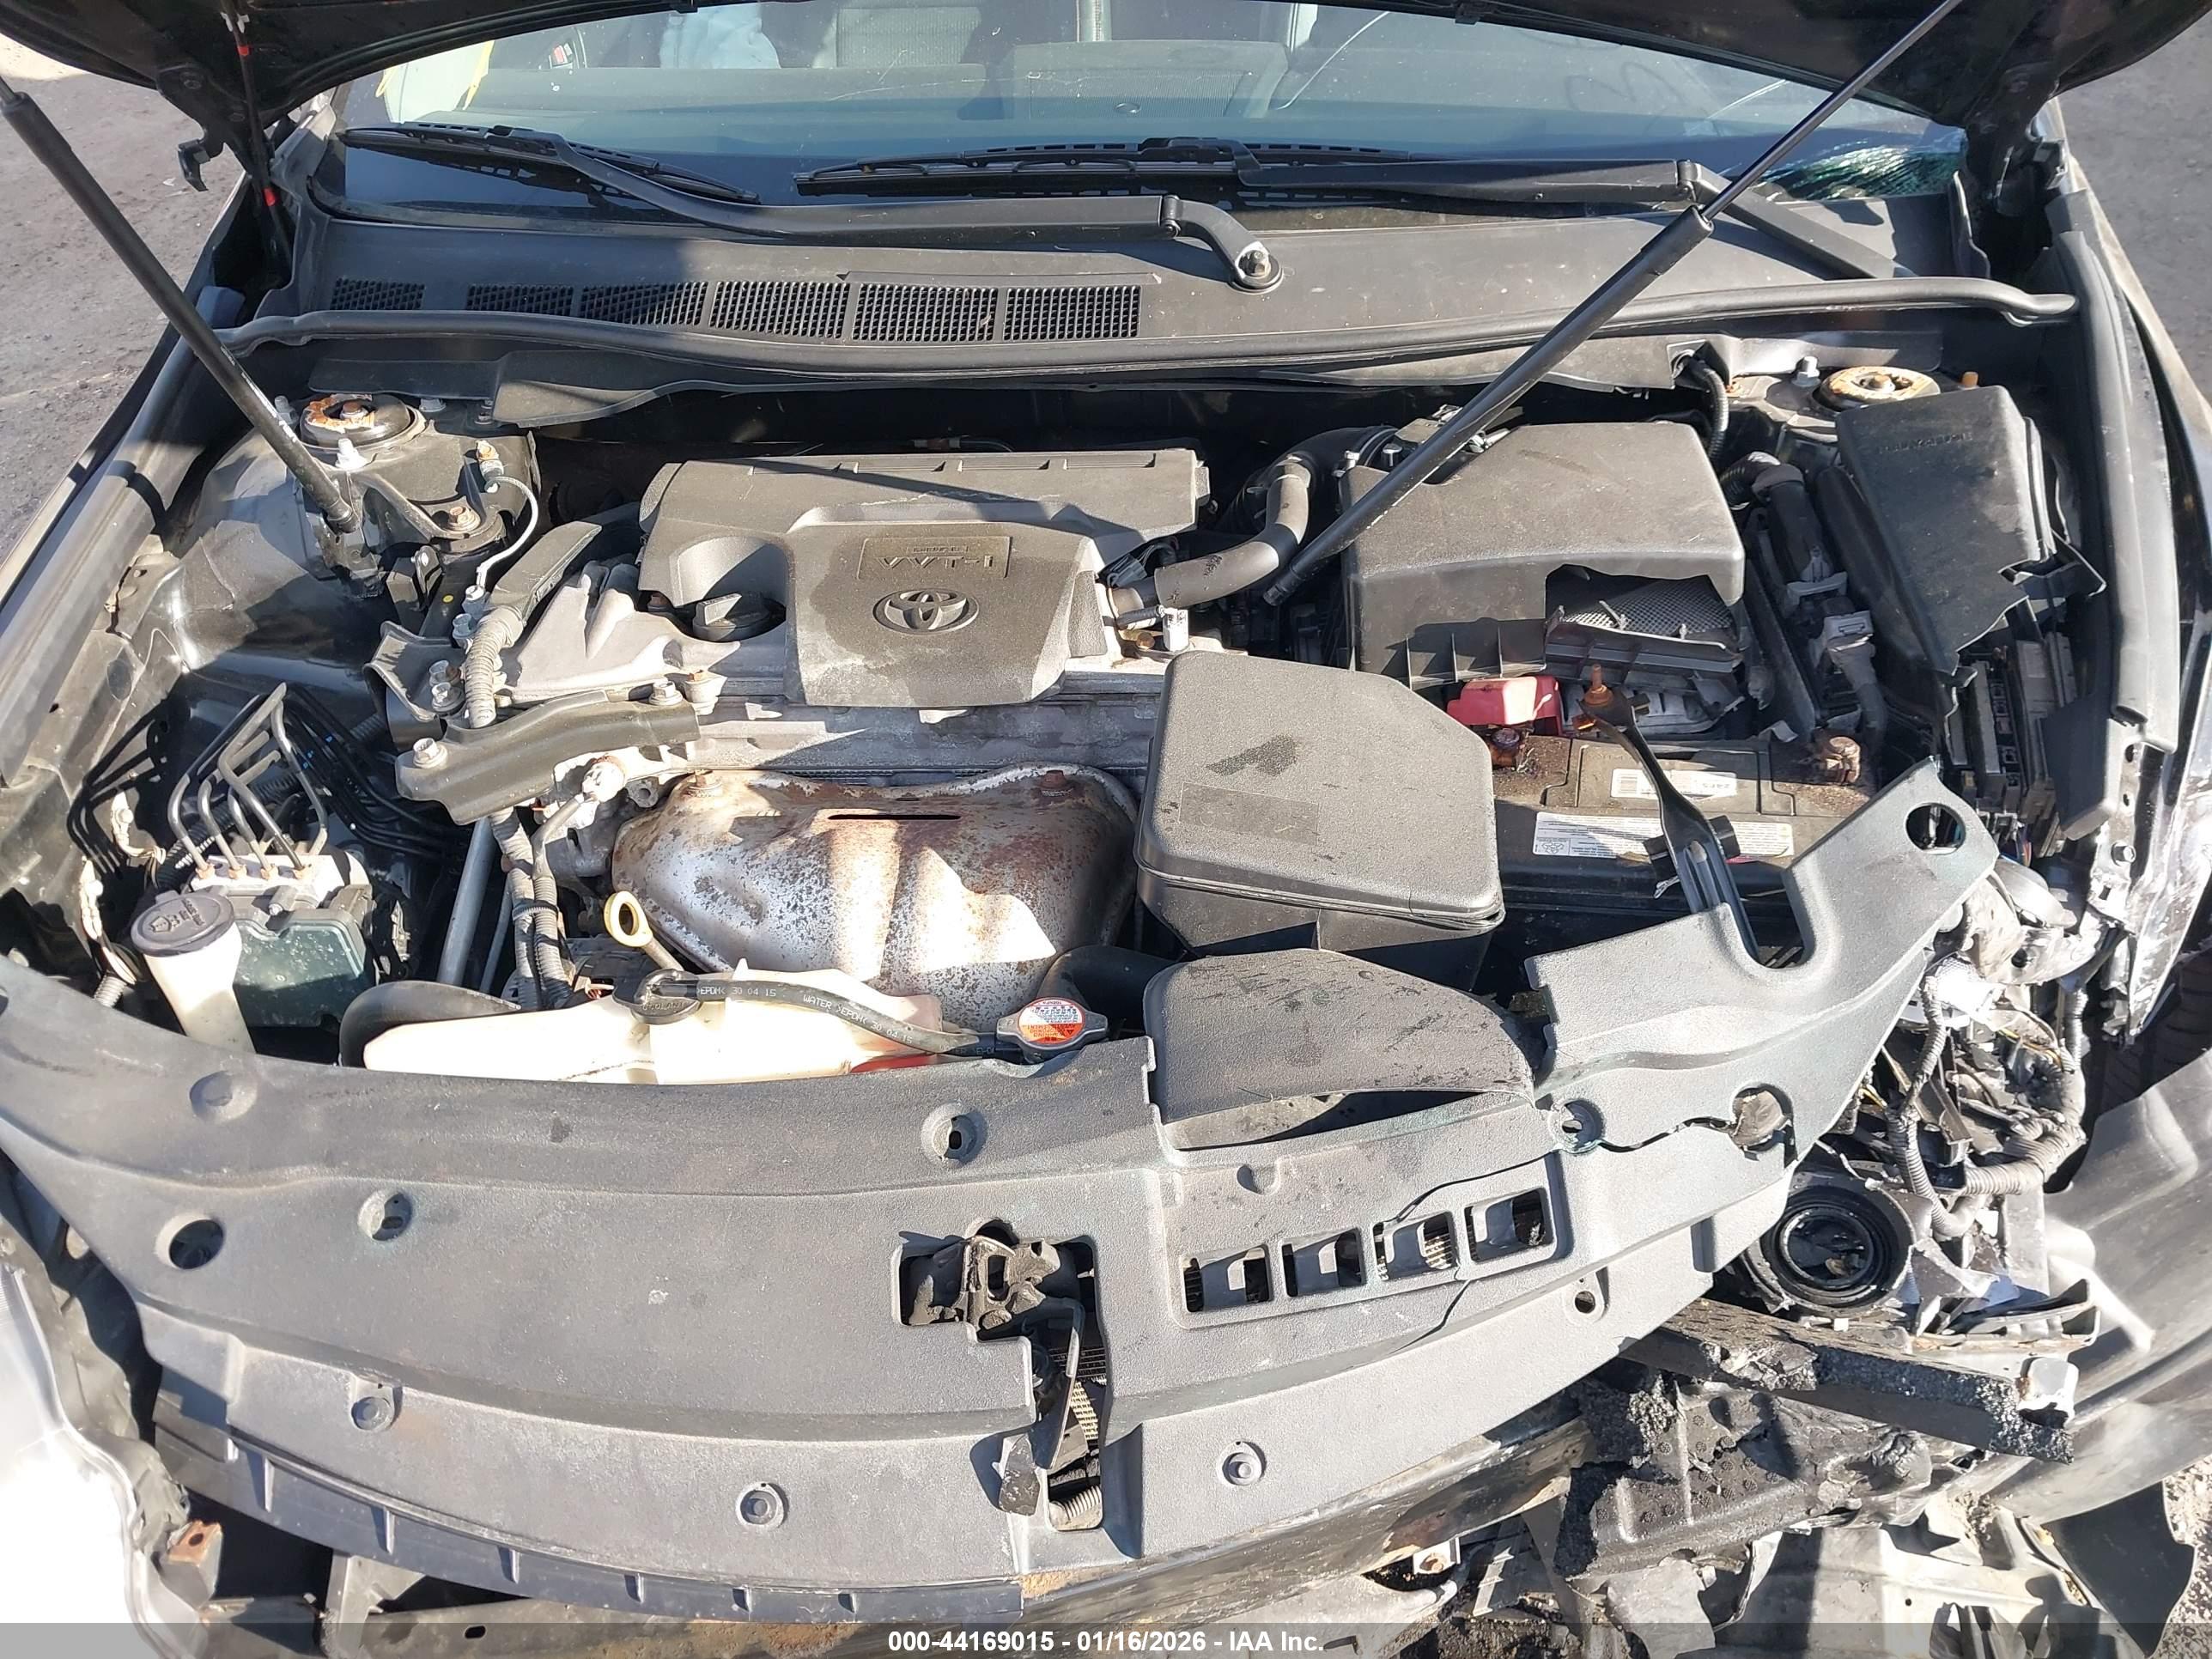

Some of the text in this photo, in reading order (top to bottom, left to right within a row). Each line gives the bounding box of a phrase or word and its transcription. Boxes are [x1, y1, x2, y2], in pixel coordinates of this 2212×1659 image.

[732, 987, 743, 995] 30
[747, 988, 759, 996] 04
[803, 994, 833, 1010] WATER
[870, 1020, 883, 1031] 30
[886, 1029, 898, 1038] 04
